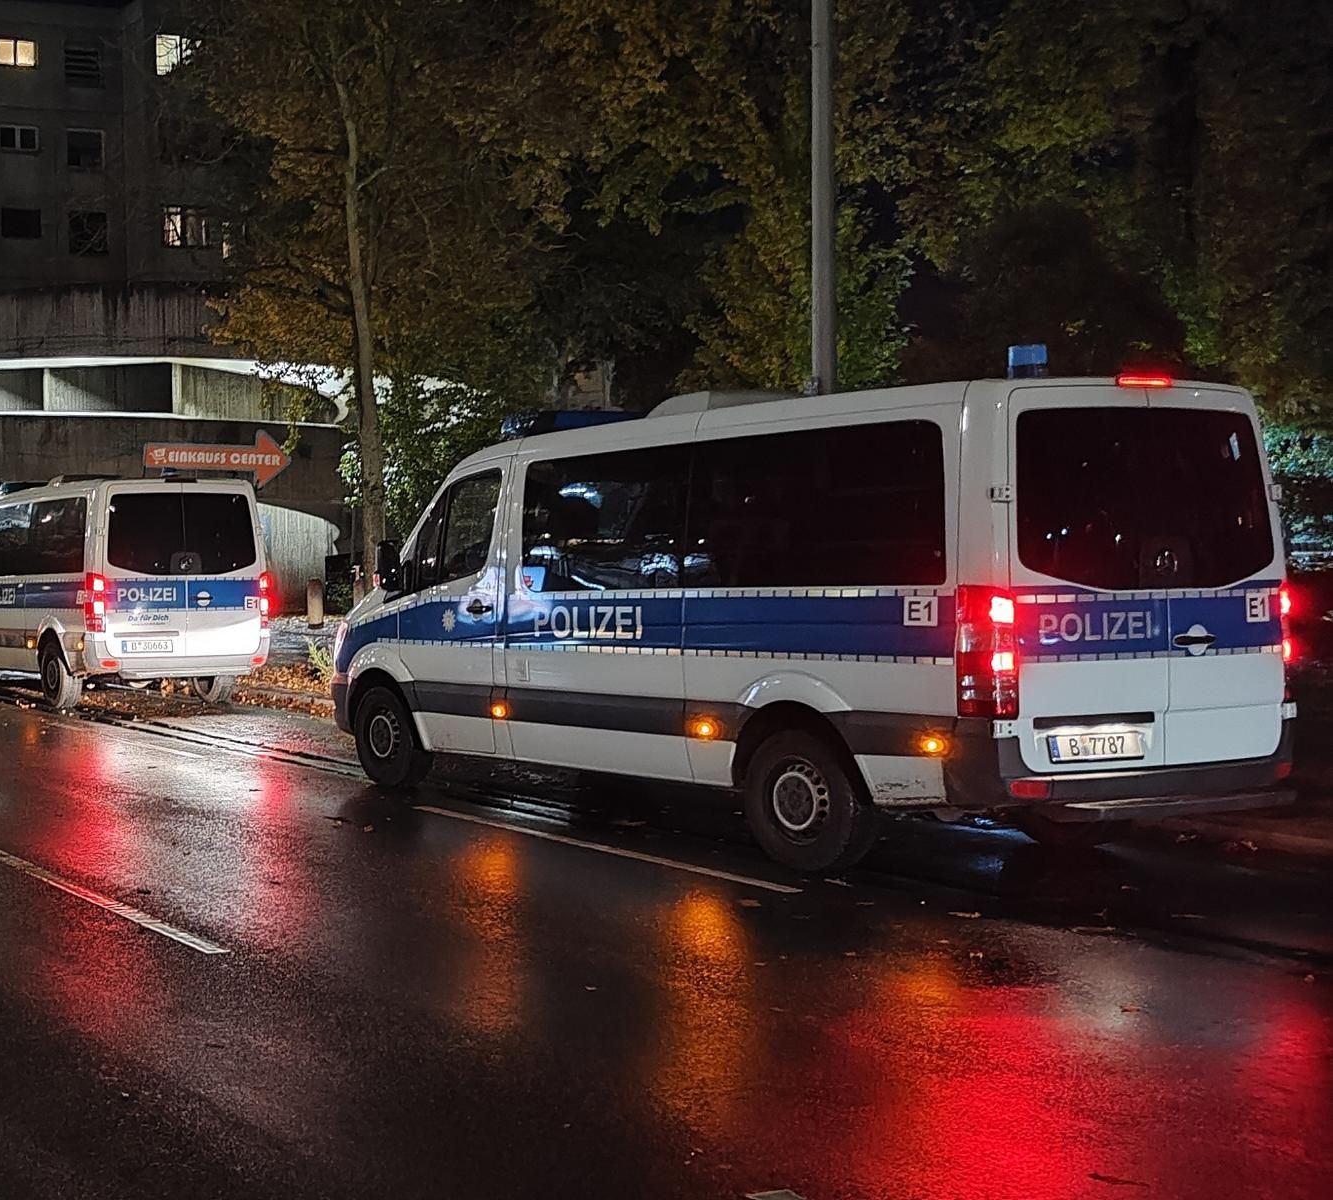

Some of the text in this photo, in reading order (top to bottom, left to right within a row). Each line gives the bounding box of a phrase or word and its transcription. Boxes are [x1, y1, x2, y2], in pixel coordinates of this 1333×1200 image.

[168, 451, 281, 466] EINKAUFS CENTER
[117, 587, 177, 601] POLIZEI
[246, 598, 259, 609] E1
[907, 600, 934, 622] E1
[1249, 597, 1266, 618] E1
[533, 605, 643, 640] POLIZEI
[1039, 610, 1152, 643] POLIZEI
[1069, 736, 1125, 756] B 7787
